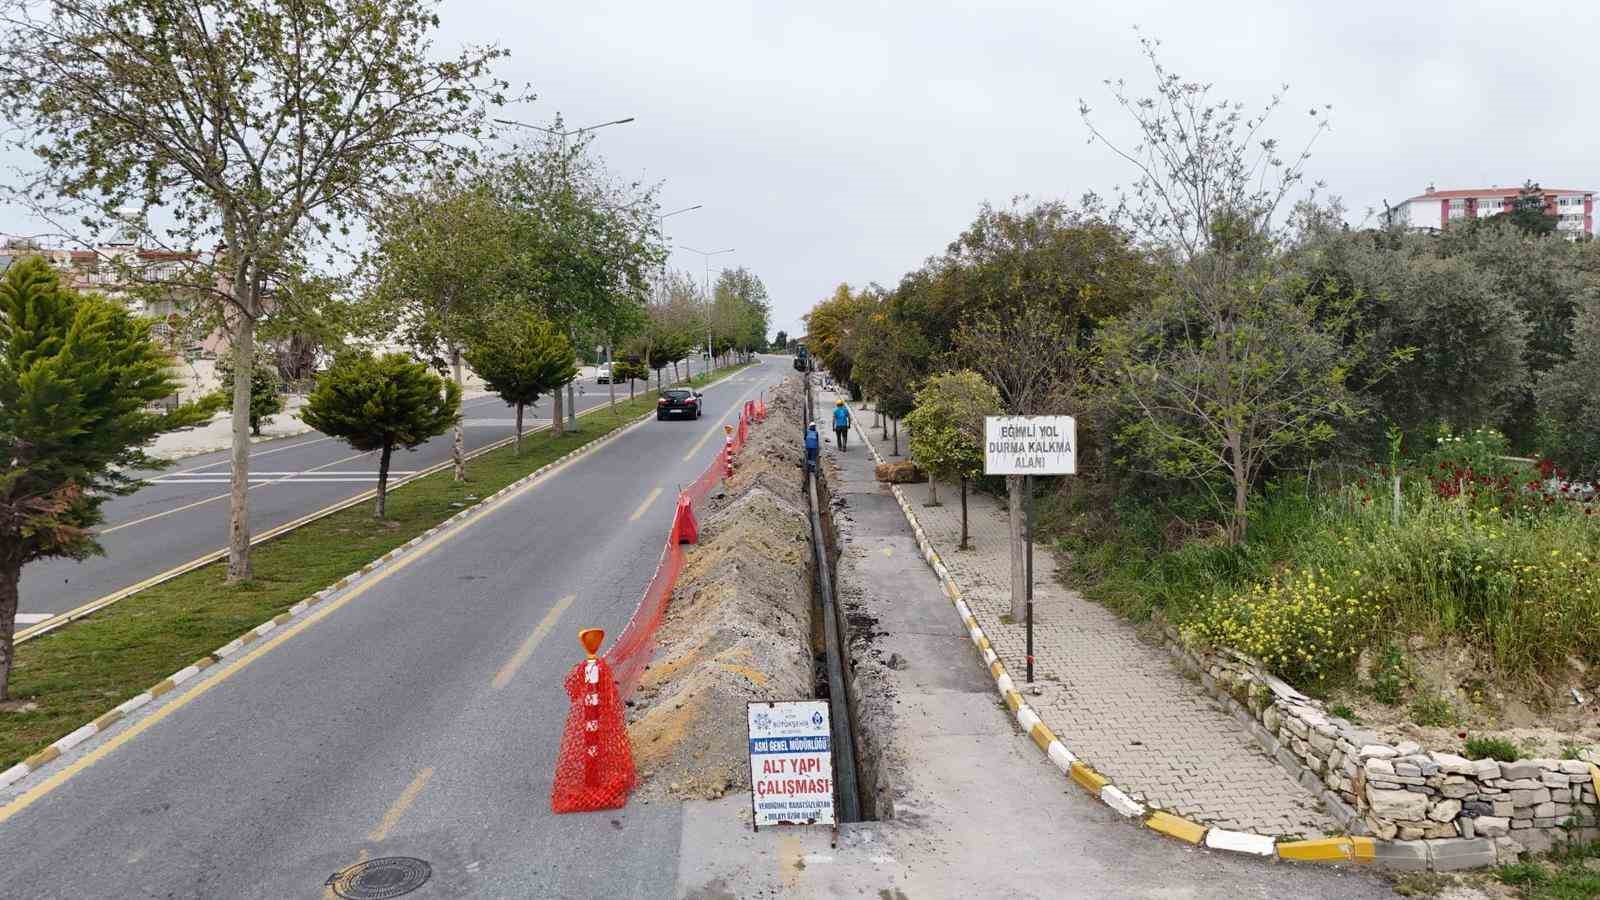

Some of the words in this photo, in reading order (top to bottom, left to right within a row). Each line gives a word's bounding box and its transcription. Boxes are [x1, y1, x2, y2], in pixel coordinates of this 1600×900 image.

[1039, 426, 1059, 437] YOL
[989, 442, 1025, 453] DURMA
[1028, 441, 1072, 453] KALKMA
[769, 740, 788, 752] GENEL
[763, 759, 786, 774] ALT
[790, 757, 821, 773] YAPI
[757, 778, 830, 798] ÇALIŞMASI
